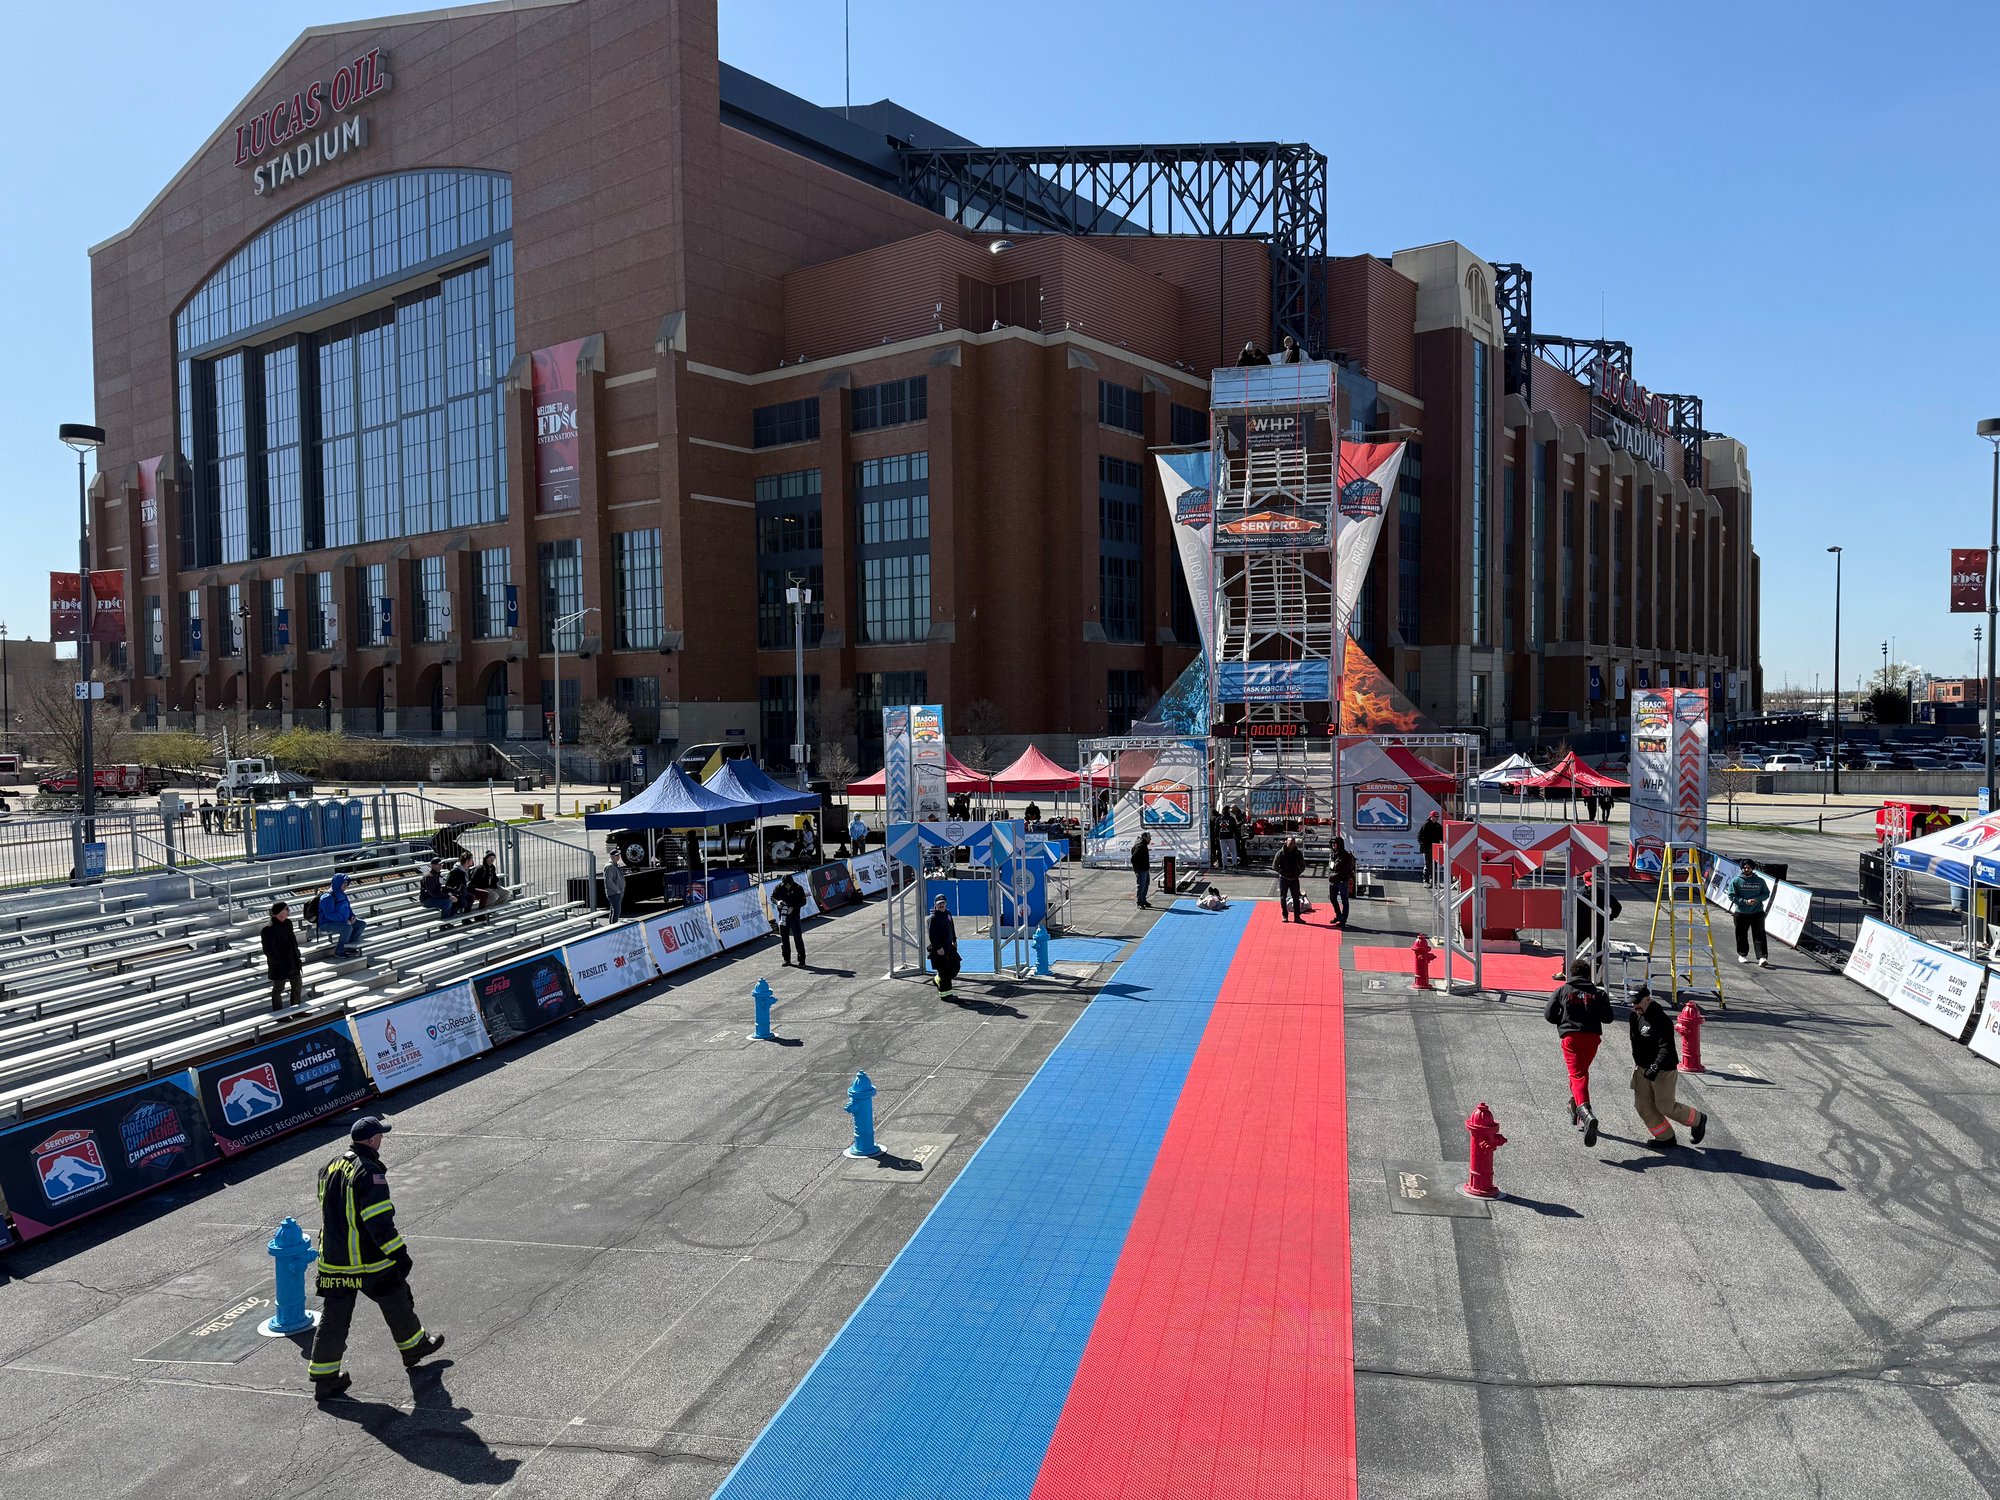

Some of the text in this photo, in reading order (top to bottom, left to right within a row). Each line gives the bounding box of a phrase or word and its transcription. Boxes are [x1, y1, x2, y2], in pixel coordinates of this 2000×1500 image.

[234, 46, 386, 167] LUCAS OIL
[254, 114, 361, 196] STADIUM
[1600, 358, 1670, 435] LUCAS OIL
[537, 404, 558, 416] WELCOME
[1255, 417, 1296, 432] WHP
[1612, 418, 1664, 471] STADIUM
[1178, 495, 1212, 506] FIREFIGHT
[1178, 504, 1212, 515] CHALLENG
[1340, 504, 1381, 513] CHAMPIONSHIP
[1177, 513, 1212, 523] CHAMPIONS
[1240, 521, 1299, 532] SERVPRO
[1351, 532, 1371, 566] BRAVE
[1190, 554, 1203, 583] LION
[1952, 573, 1984, 584] FDIC
[1243, 686, 1260, 694] TASK
[1261, 685, 1285, 693] FORCE
[914, 715, 939, 723] SEASON
[1233, 725, 1238, 735] 1
[1327, 724, 1336, 735] 2
[925, 785, 940, 795] LION
[1643, 778, 1664, 790] WHP
[1591, 787, 1612, 797] LION
[673, 918, 704, 948] LION
[613, 955, 628, 969] 3M
[582, 962, 609, 979] RESILITE
[485, 977, 511, 996] SKB
[1948, 975, 1968, 989] SAVING
[1948, 985, 1963, 997] LIVES
[1936, 994, 1967, 1013] PROTECTING
[437, 1012, 477, 1034] GoRescue
[400, 1040, 414, 1050] 2025
[291, 1048, 337, 1072] SOUTHEAST
[376, 1057, 402, 1073] POLICE
[406, 1049, 423, 1062] FIRE
[377, 1049, 391, 1059] BHM
[299, 1062, 337, 1082] REGION
[121, 1110, 176, 1139] FIREFIGHTER
[227, 1087, 367, 1151] SOUTHEAST REGIONAL CHAMPIONSHIP
[44, 1132, 82, 1152] SERVPRO
[126, 1120, 180, 1152] CHALLENGE
[86, 1142, 97, 1165] FCL
[128, 1134, 187, 1164] CHAMPIONSHIP
[150, 1147, 171, 1160] SERIES
[320, 1277, 363, 1291] HOFFMAN
